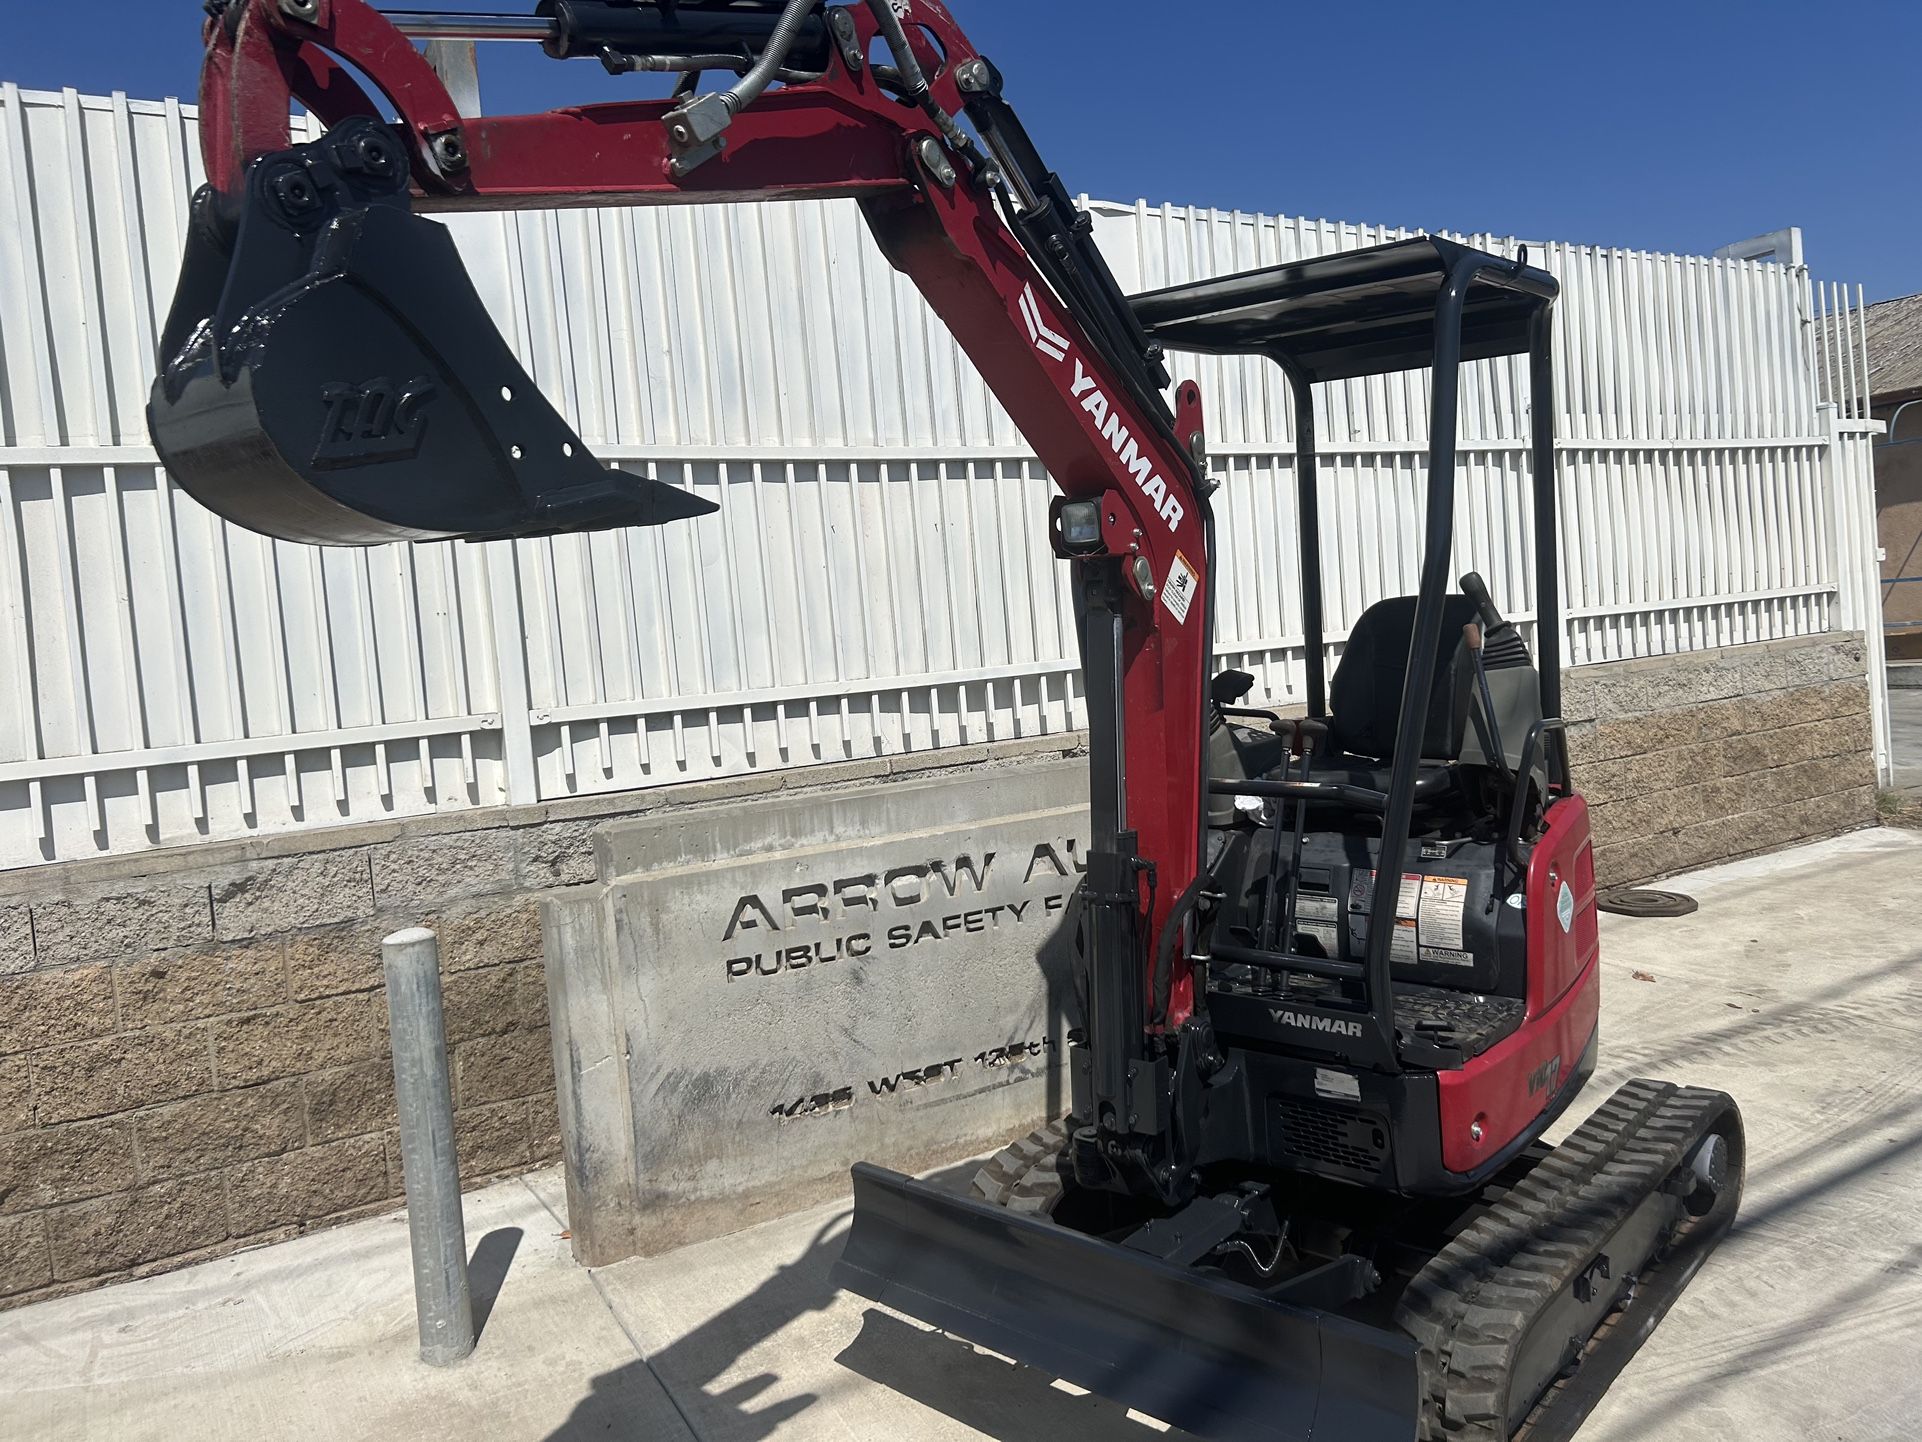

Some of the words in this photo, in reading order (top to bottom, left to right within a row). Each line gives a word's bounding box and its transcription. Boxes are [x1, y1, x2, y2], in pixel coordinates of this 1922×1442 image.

[1070, 357, 1184, 533] YANMAR
[721, 851, 997, 942] ARROW
[726, 932, 872, 983] PUBLIC
[887, 899, 1032, 950] SAFETY
[1431, 949, 1469, 960] WARNING
[1268, 1007, 1363, 1038] YANMAR
